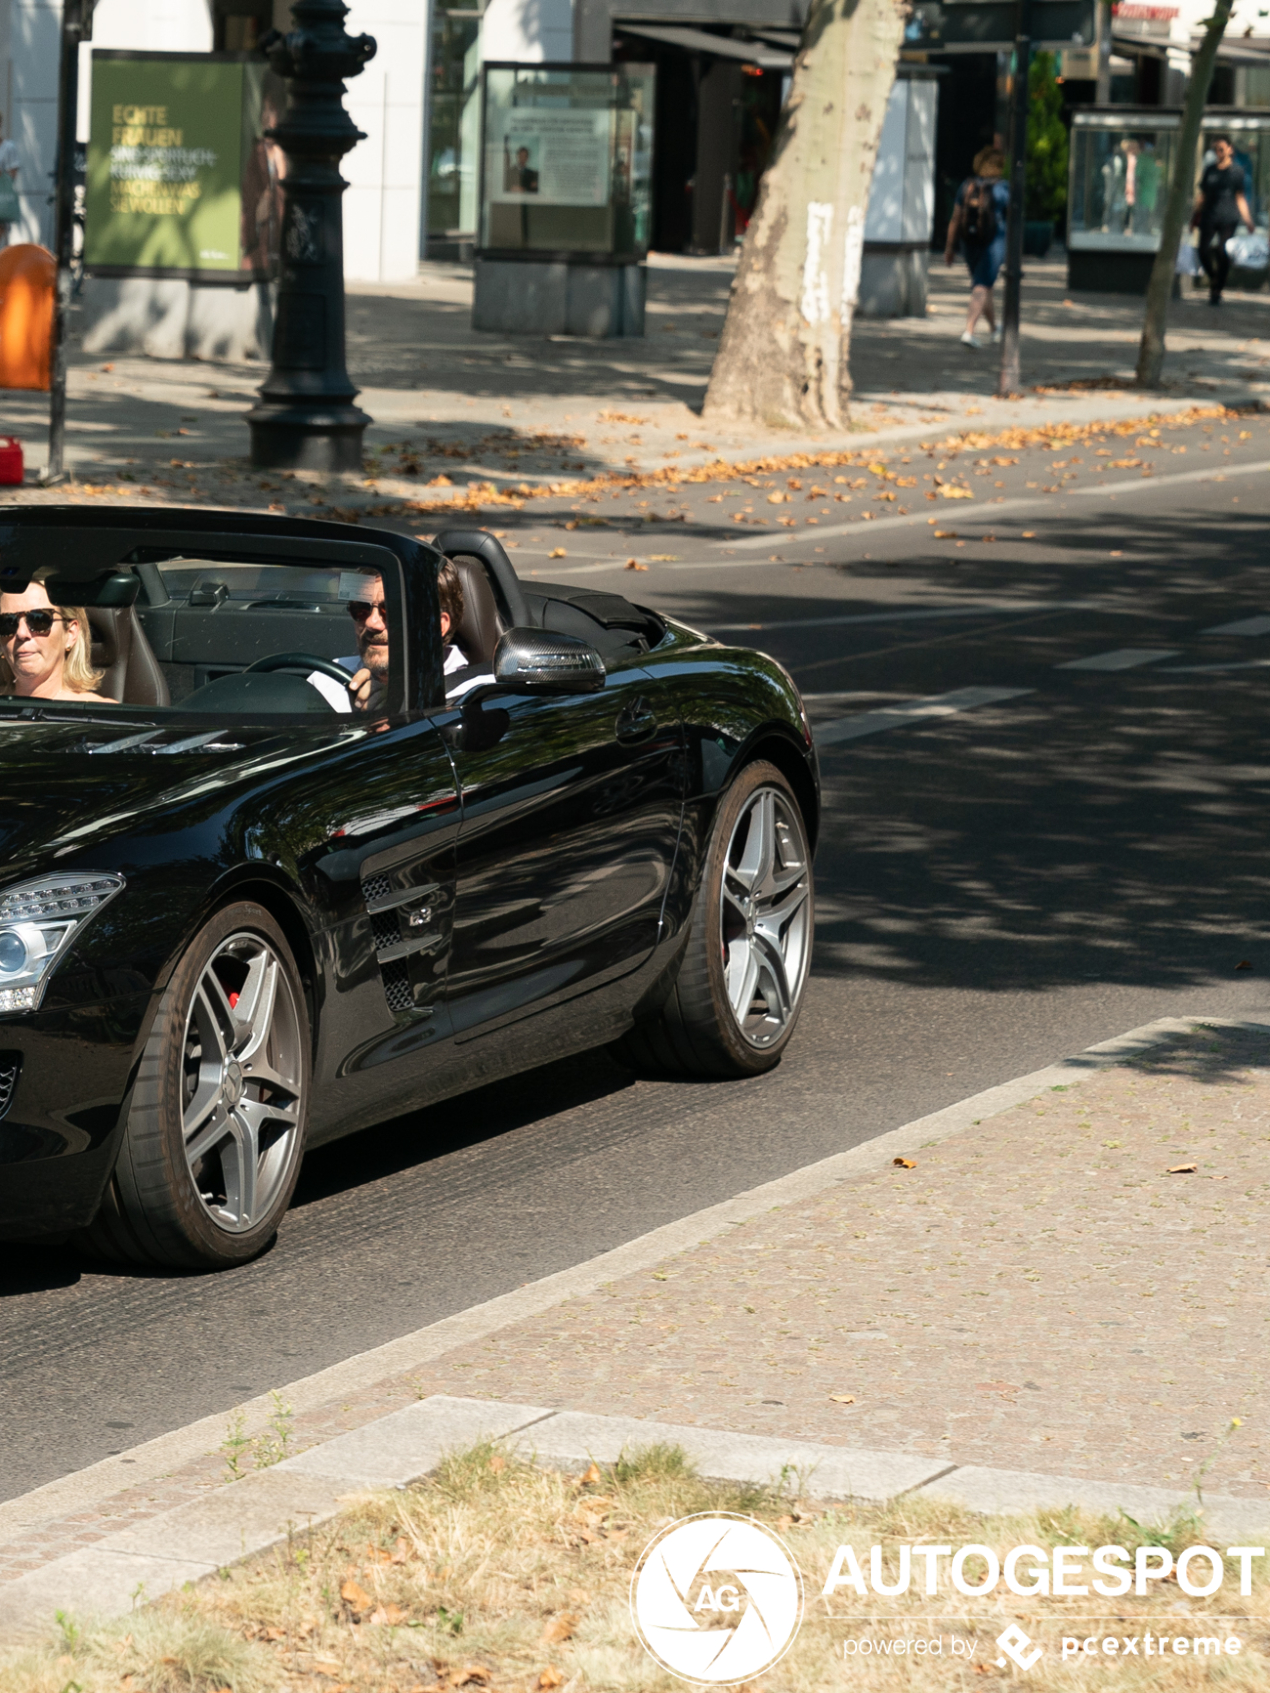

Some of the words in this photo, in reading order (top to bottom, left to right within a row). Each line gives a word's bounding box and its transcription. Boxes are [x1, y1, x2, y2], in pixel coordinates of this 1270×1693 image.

[112, 104, 167, 125] ECHTE
[112, 126, 183, 147] FRAUEN
[111, 180, 168, 197] MACHEN
[169, 181, 201, 199] WAS
[129, 198, 186, 215] WOLLEN
